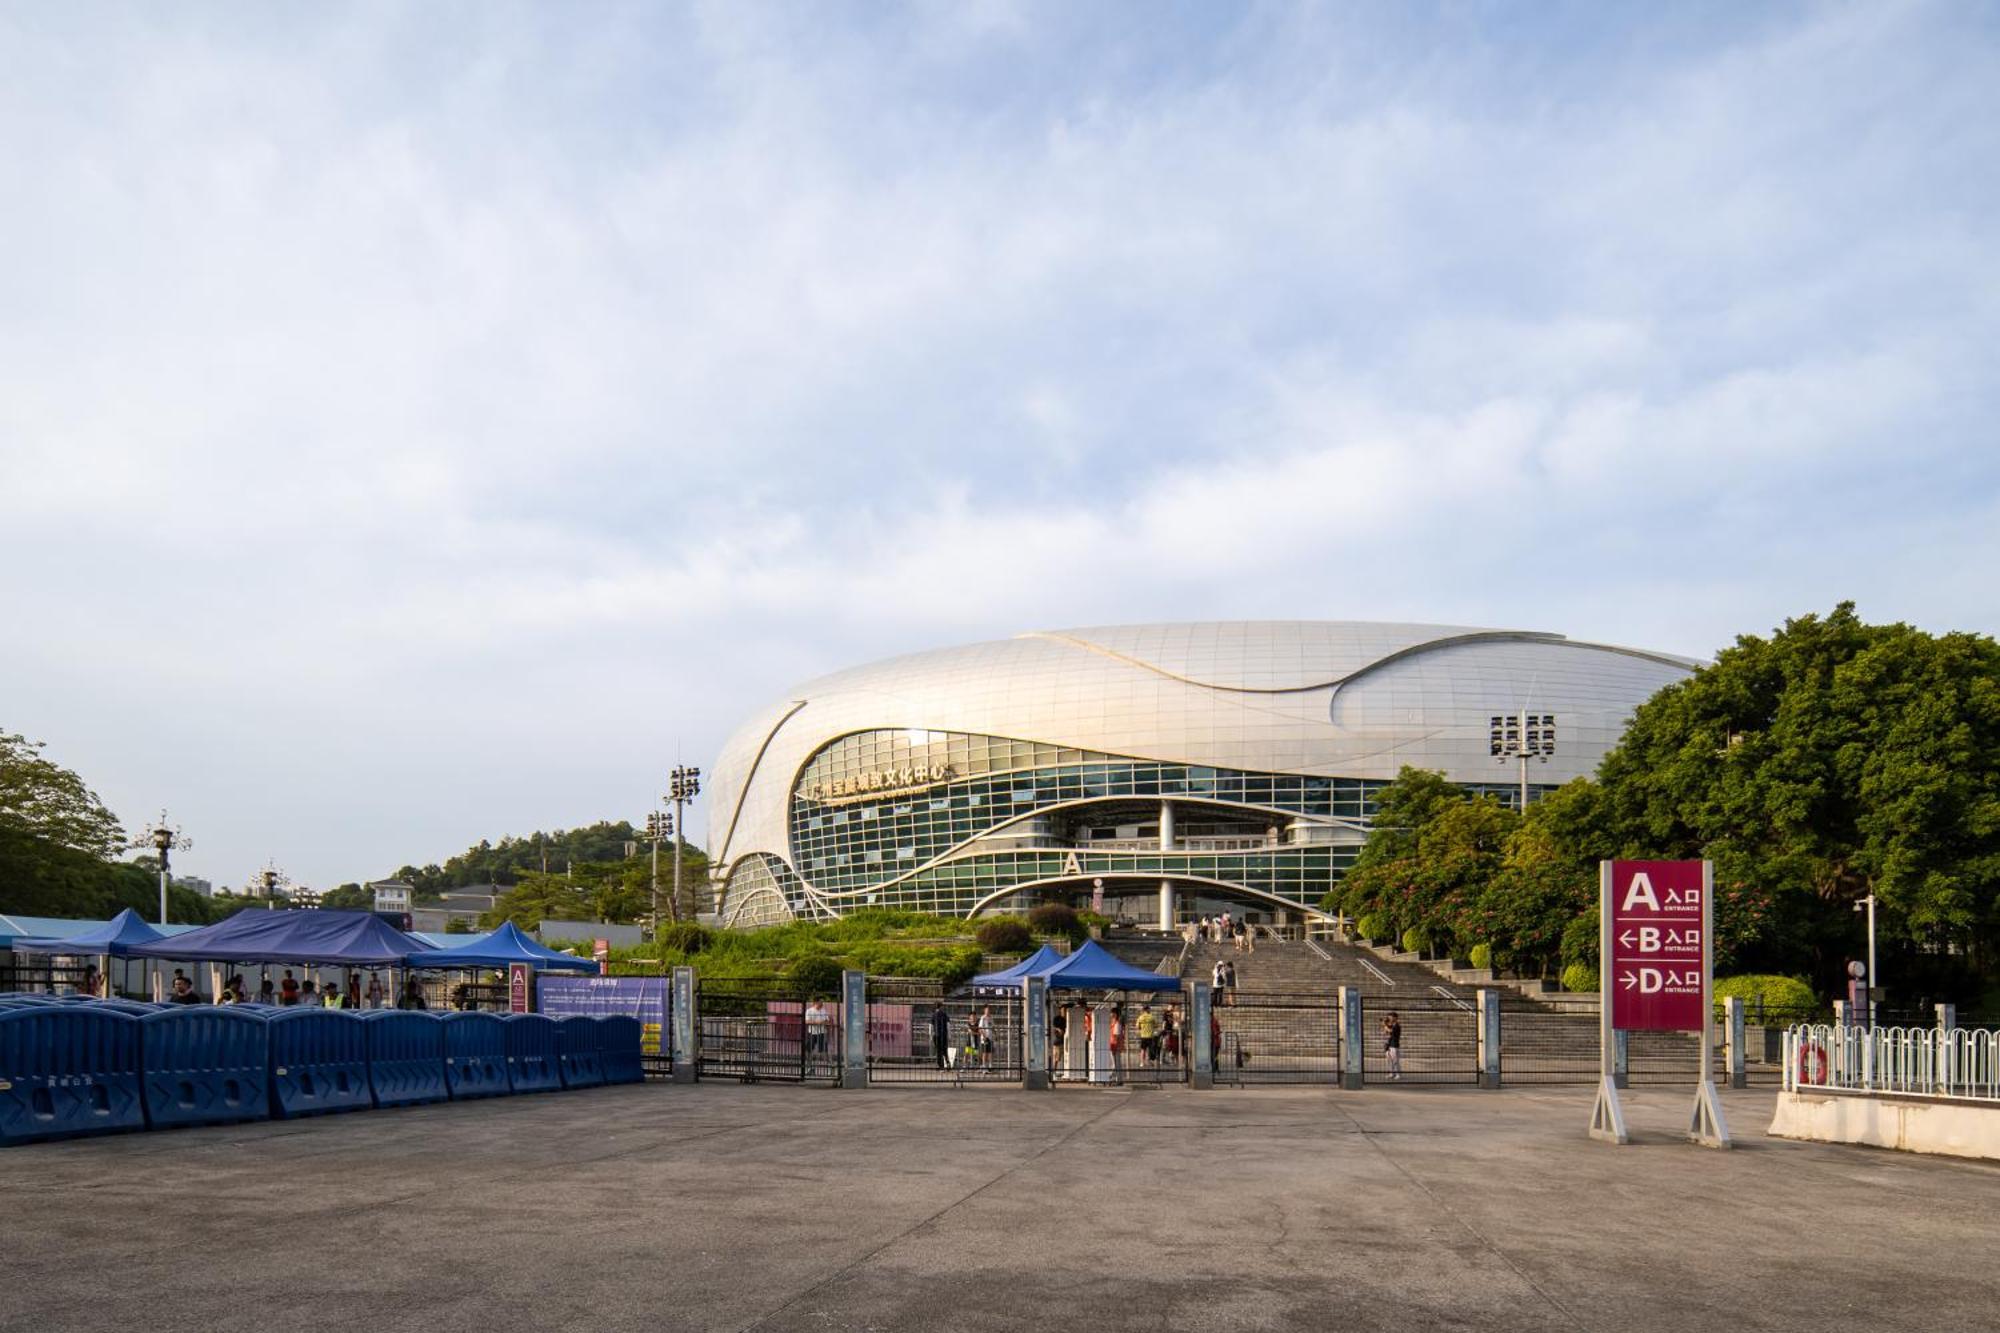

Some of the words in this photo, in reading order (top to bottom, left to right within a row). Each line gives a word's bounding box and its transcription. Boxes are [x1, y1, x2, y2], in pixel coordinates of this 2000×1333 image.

[1063, 852, 1082, 875] A
[1622, 872, 1660, 912] A
[1664, 888, 1700, 904] 入口
[1639, 927, 1661, 953] B
[1664, 929, 1700, 944] 入口
[512, 970, 524, 984] A
[1639, 968, 1663, 994] D
[1664, 970, 1700, 985] 入口
